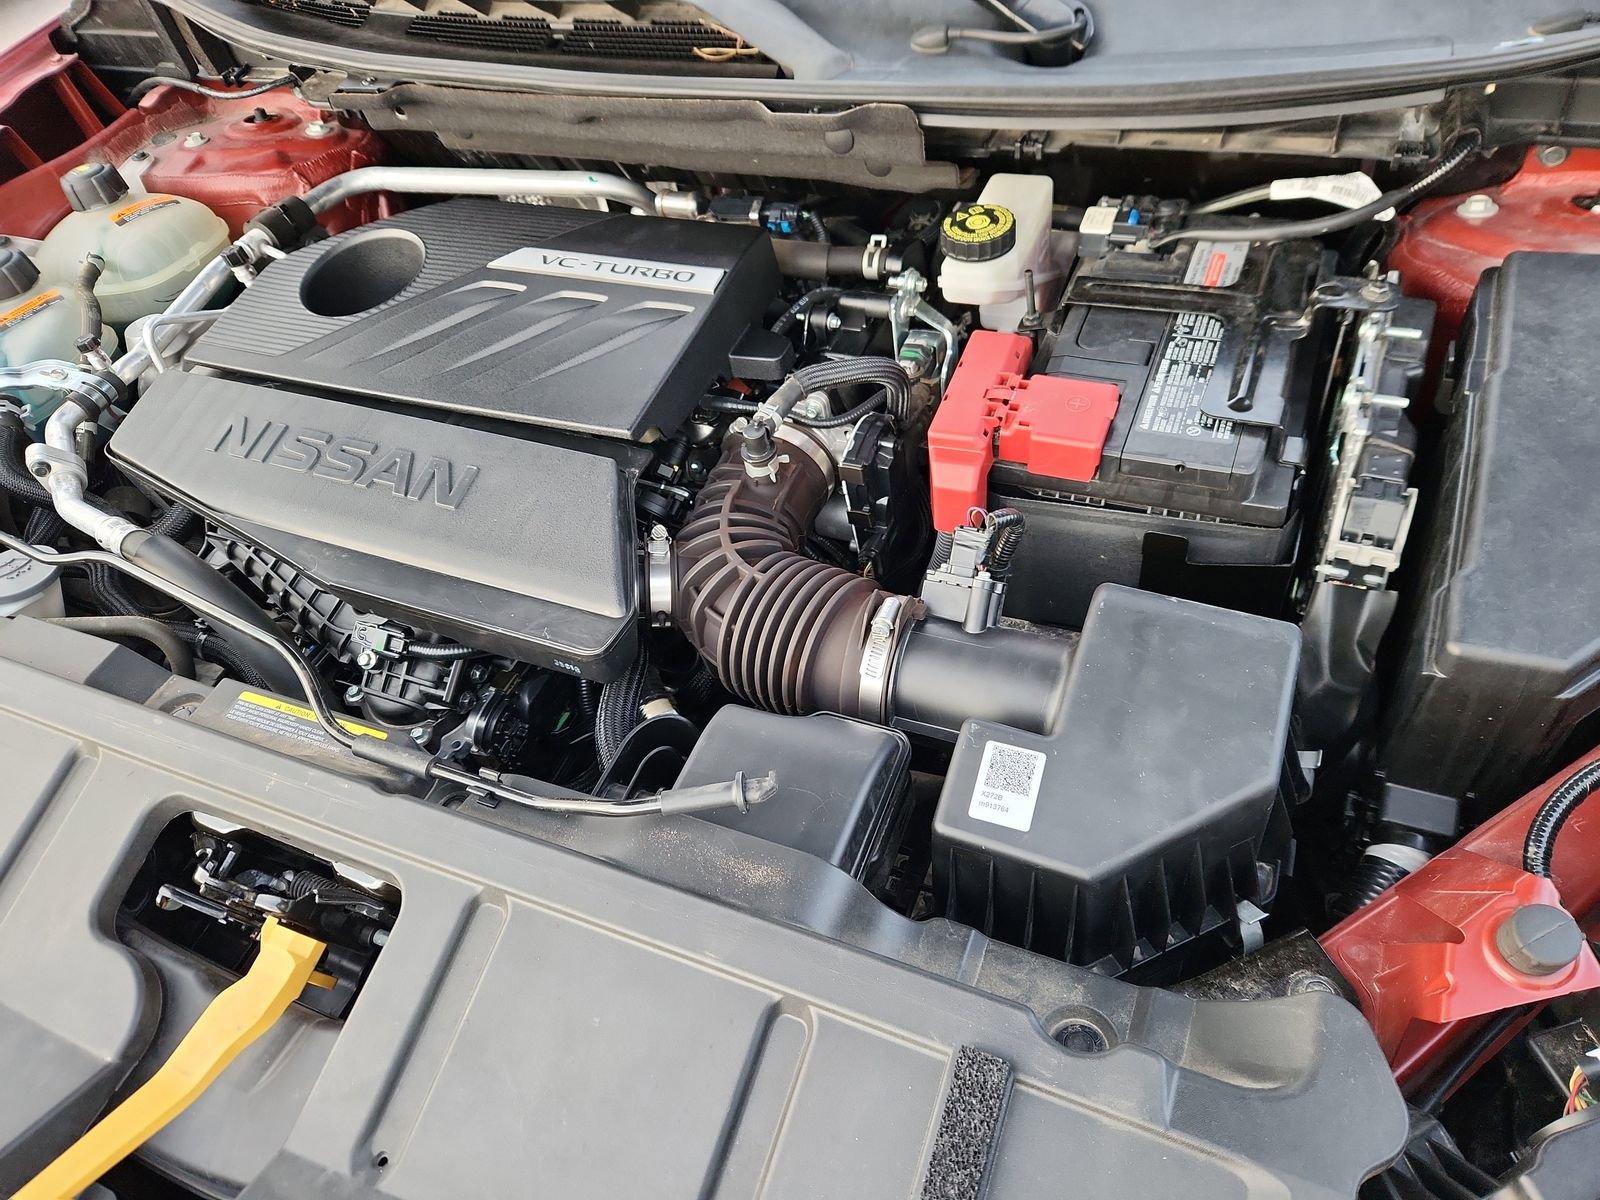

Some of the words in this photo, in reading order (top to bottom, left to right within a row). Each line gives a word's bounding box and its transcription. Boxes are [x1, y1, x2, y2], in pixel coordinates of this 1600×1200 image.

[541, 254, 696, 283] VC-TURBO
[205, 415, 480, 511] NISSAN
[284, 705, 311, 718] CAUTION
